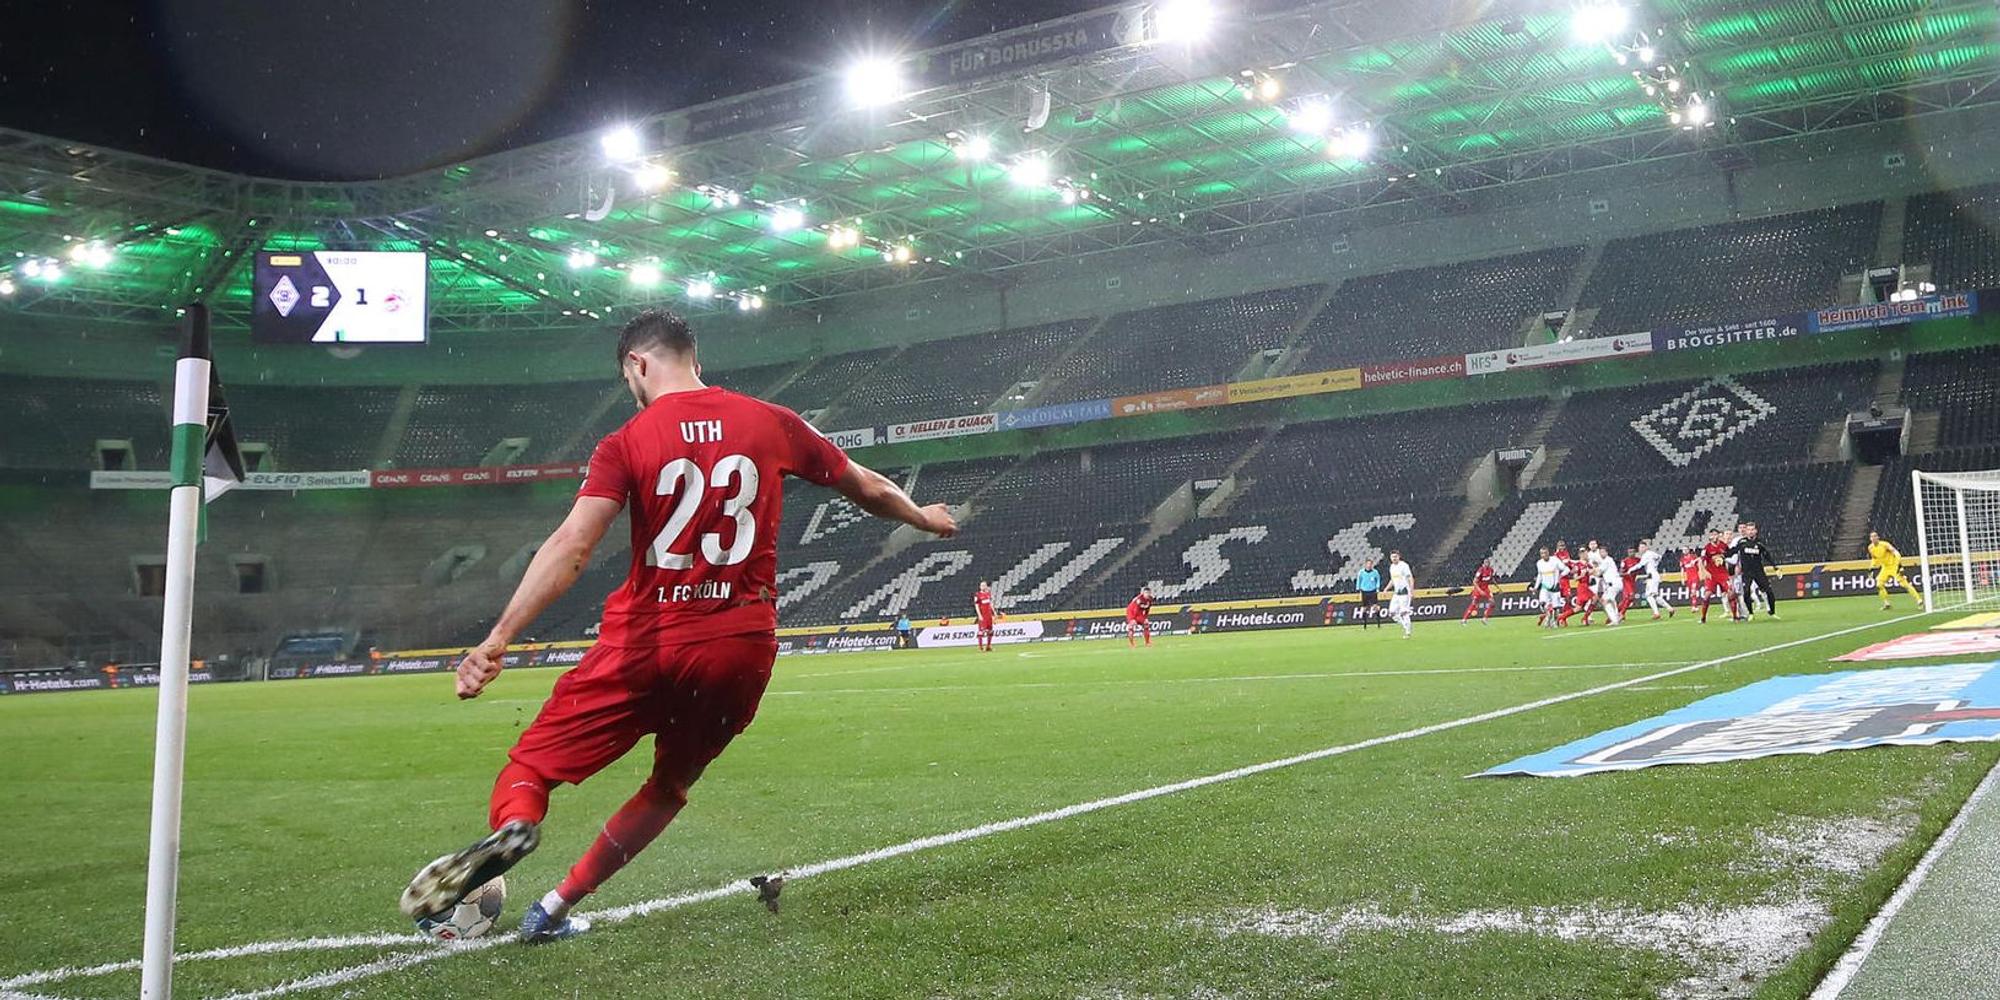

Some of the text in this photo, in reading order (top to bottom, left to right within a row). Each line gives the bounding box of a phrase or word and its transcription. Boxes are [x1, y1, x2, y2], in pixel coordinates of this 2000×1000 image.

[311, 286, 368, 307] 2 1
[1817, 294, 1969, 326] Heinrich Temmink
[1666, 326, 1798, 350] BROGSITTER.de
[1364, 362, 1463, 383] helvetic-finance.ch
[680, 419, 723, 444] UTH
[910, 421, 946, 434] NELLEN
[947, 420, 955, 429] &
[957, 415, 994, 429] QUACK
[836, 433, 862, 448] OHG
[646, 454, 759, 571] 23
[658, 579, 731, 603] 1. FC KÖLN
[1216, 610, 1305, 627] H-Hotels.com
[827, 634, 897, 648] H-Hotels.com
[933, 632, 950, 641] WIR
[952, 631, 975, 640] SIND
